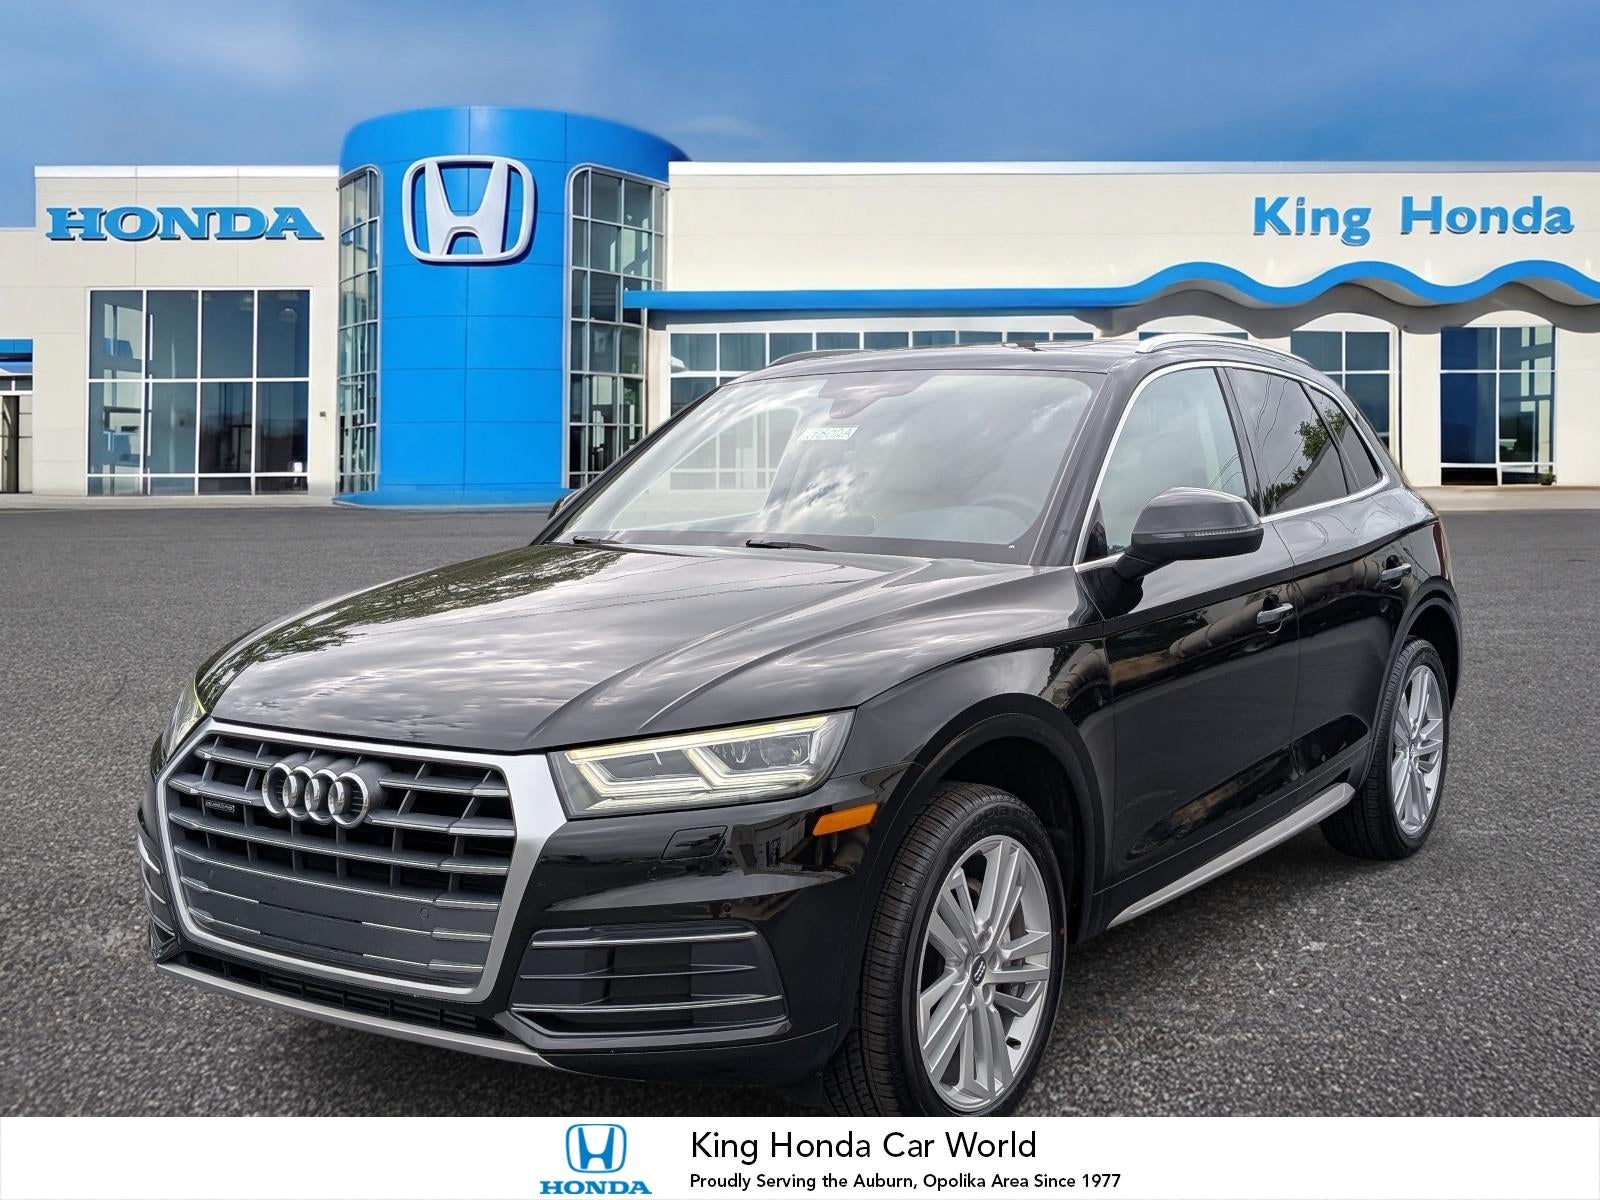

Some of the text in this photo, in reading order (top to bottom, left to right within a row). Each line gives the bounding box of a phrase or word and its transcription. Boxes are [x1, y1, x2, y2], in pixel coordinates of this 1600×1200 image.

[46, 206, 324, 241] HONDA
[1253, 195, 1575, 247] King Honda
